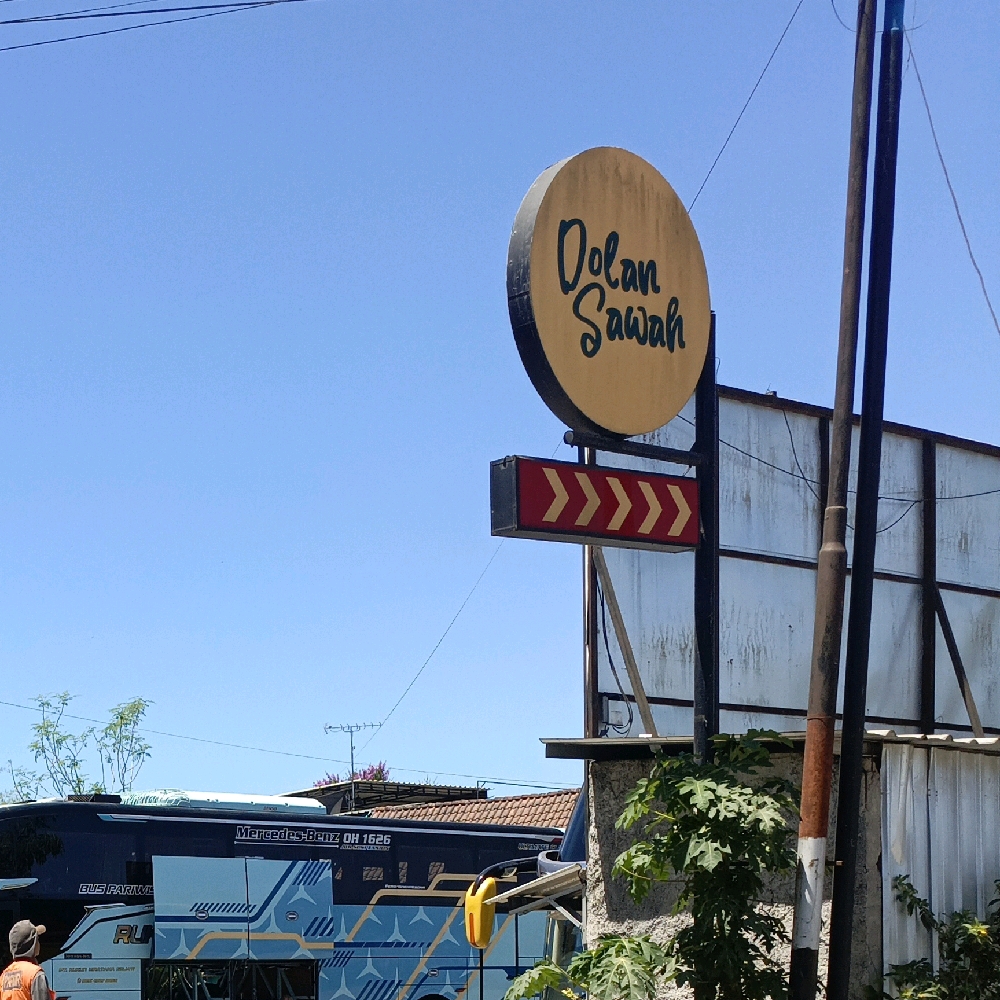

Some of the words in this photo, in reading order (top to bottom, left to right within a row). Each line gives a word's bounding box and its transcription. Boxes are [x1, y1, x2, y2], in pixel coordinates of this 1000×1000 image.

[557, 218, 660, 296] Dolan
[572, 282, 686, 358] Sawah
[235, 826, 340, 843] Mercedes-Benz
[343, 833, 360, 844] OH
[362, 834, 391, 845] 1626
[78, 884, 106, 895] BUS
